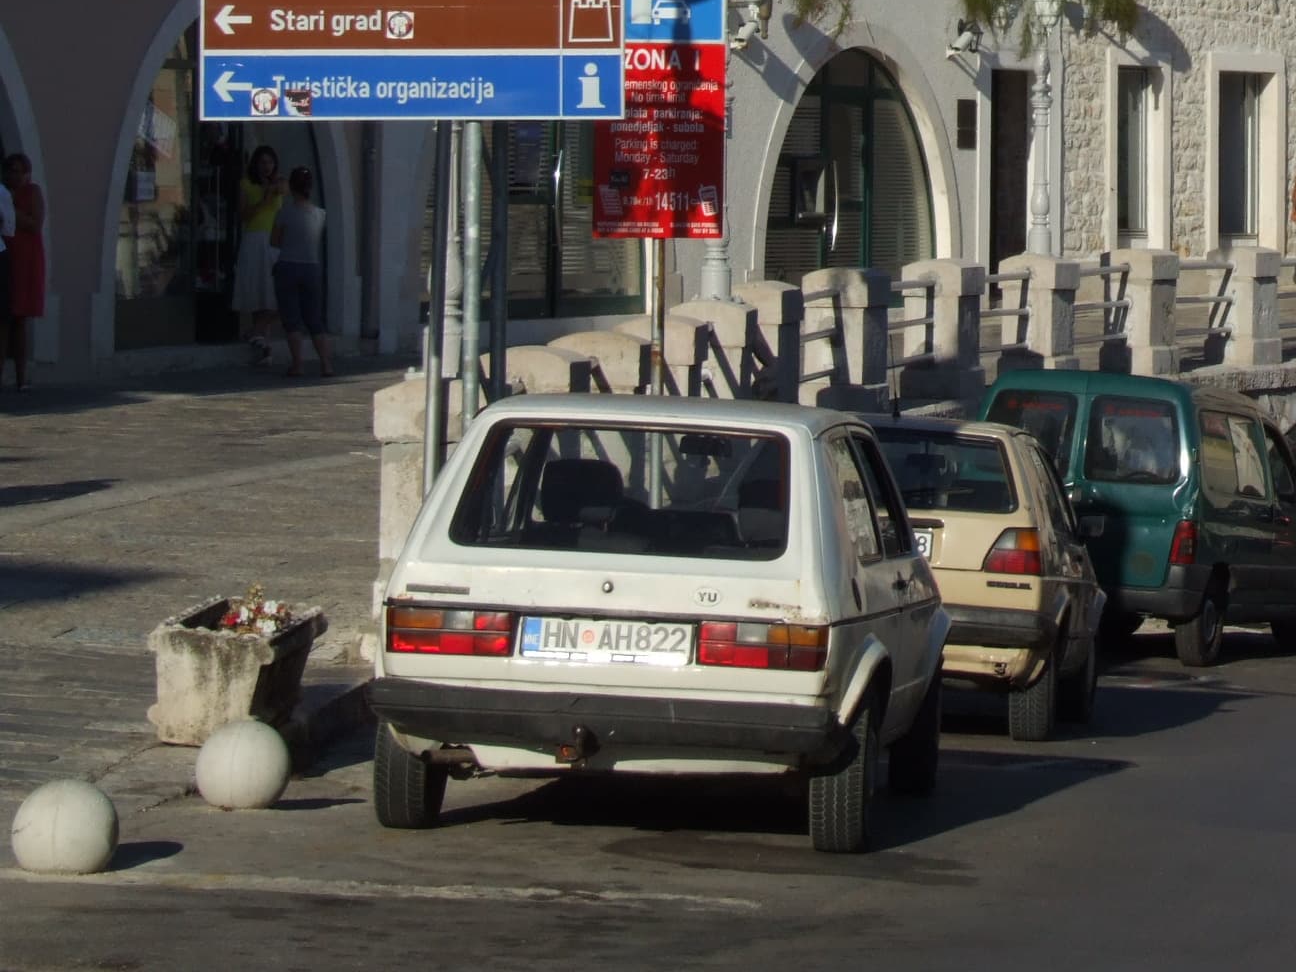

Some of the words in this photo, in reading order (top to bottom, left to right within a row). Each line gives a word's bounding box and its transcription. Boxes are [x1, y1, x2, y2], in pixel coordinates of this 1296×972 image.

[270, 9, 325, 31] Stari
[331, 9, 383, 37] grad
[624, 48, 683, 71] ZONA
[272, 75, 370, 99] Turistička
[376, 77, 496, 105] organizacija
[624, 79, 668, 93] emenskog
[614, 138, 648, 152] Parking
[650, 138, 659, 149] is
[614, 151, 651, 165] Monday
[659, 151, 700, 165] Saturday
[655, 191, 689, 211] 14511
[698, 591, 718, 604] YU
[543, 619, 580, 650] HN
[598, 622, 688, 654] AH822
